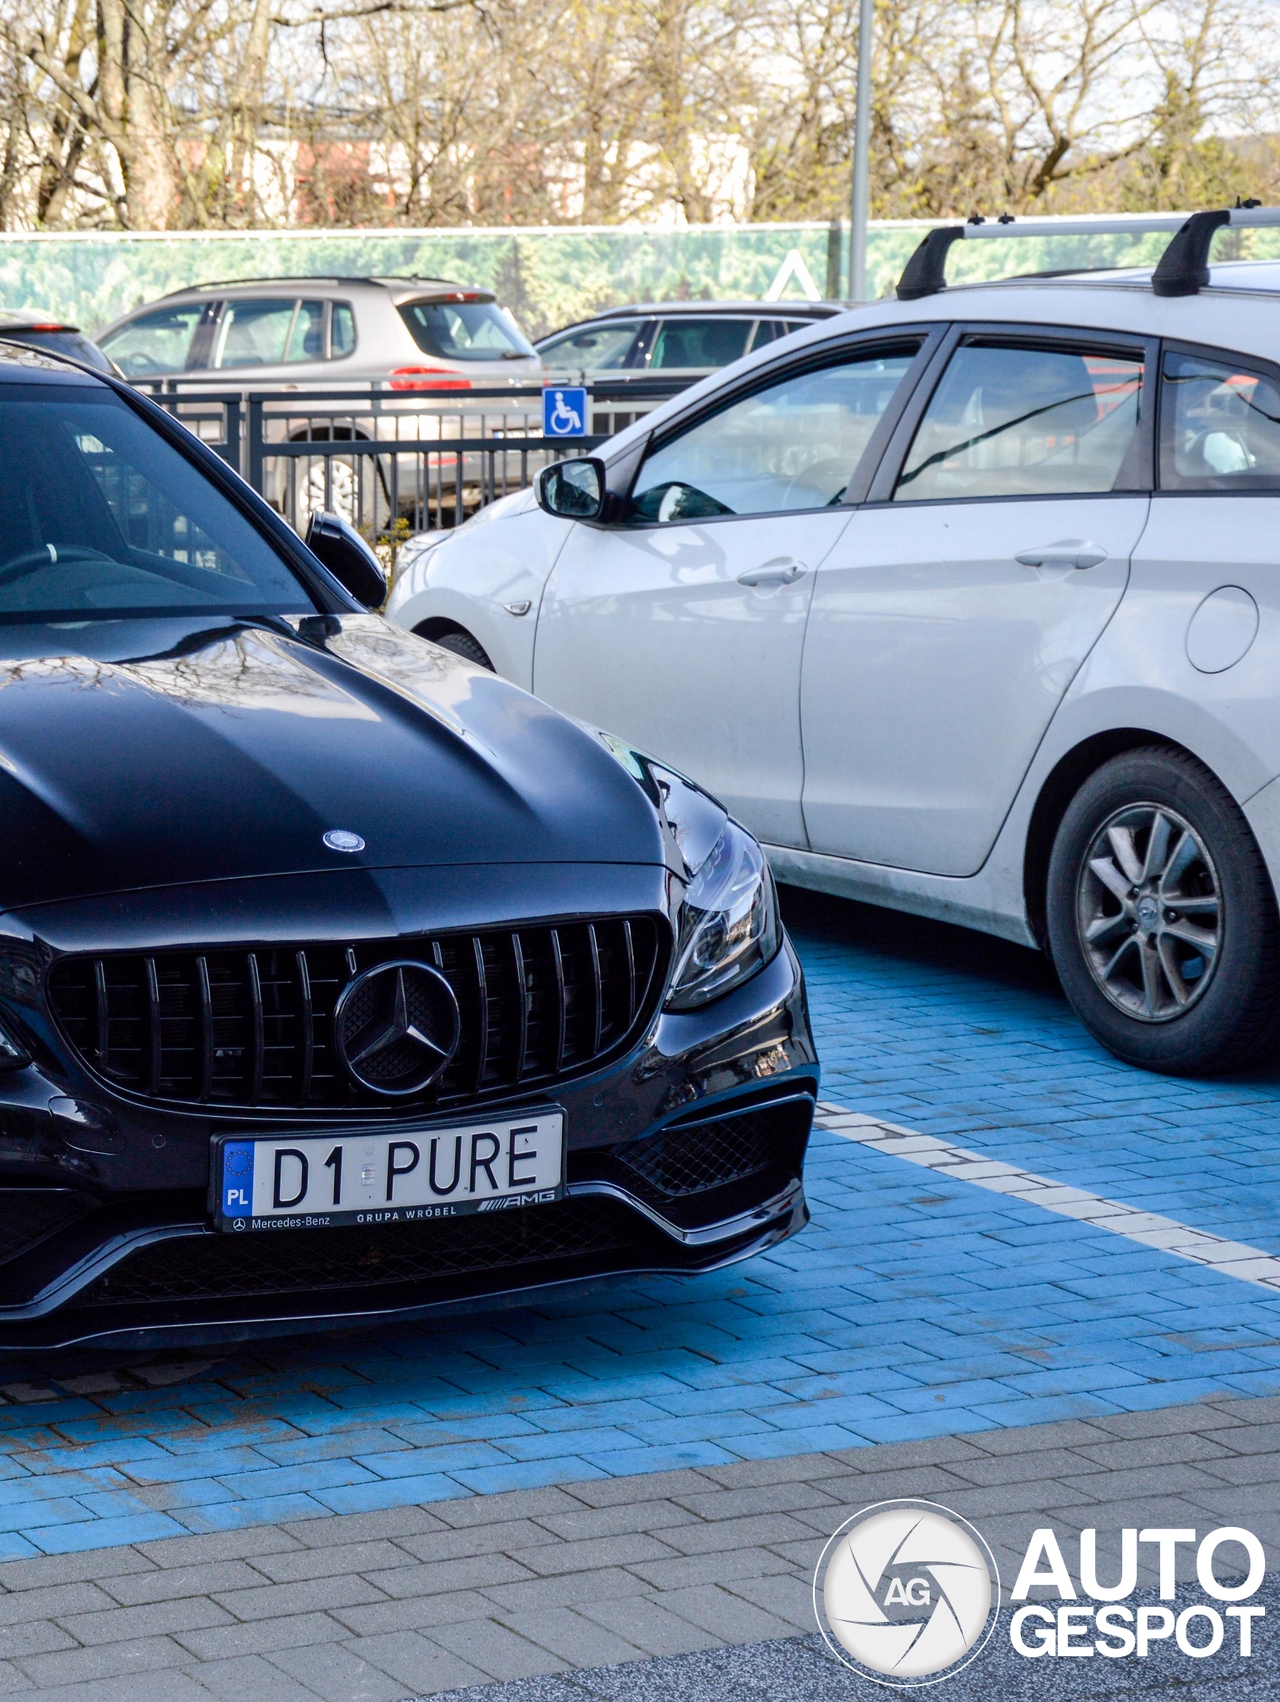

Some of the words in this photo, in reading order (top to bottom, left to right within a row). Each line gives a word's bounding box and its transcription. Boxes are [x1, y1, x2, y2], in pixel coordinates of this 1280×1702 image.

[272, 1145, 343, 1209] D1
[385, 1124, 538, 1202] PURE
[227, 1188, 249, 1206] PL
[502, 1190, 556, 1208] AMG
[251, 1216, 330, 1229] Mercedes-Benz
[357, 1211, 400, 1223] GRUPA
[405, 1206, 457, 1219] WRÓBEL
